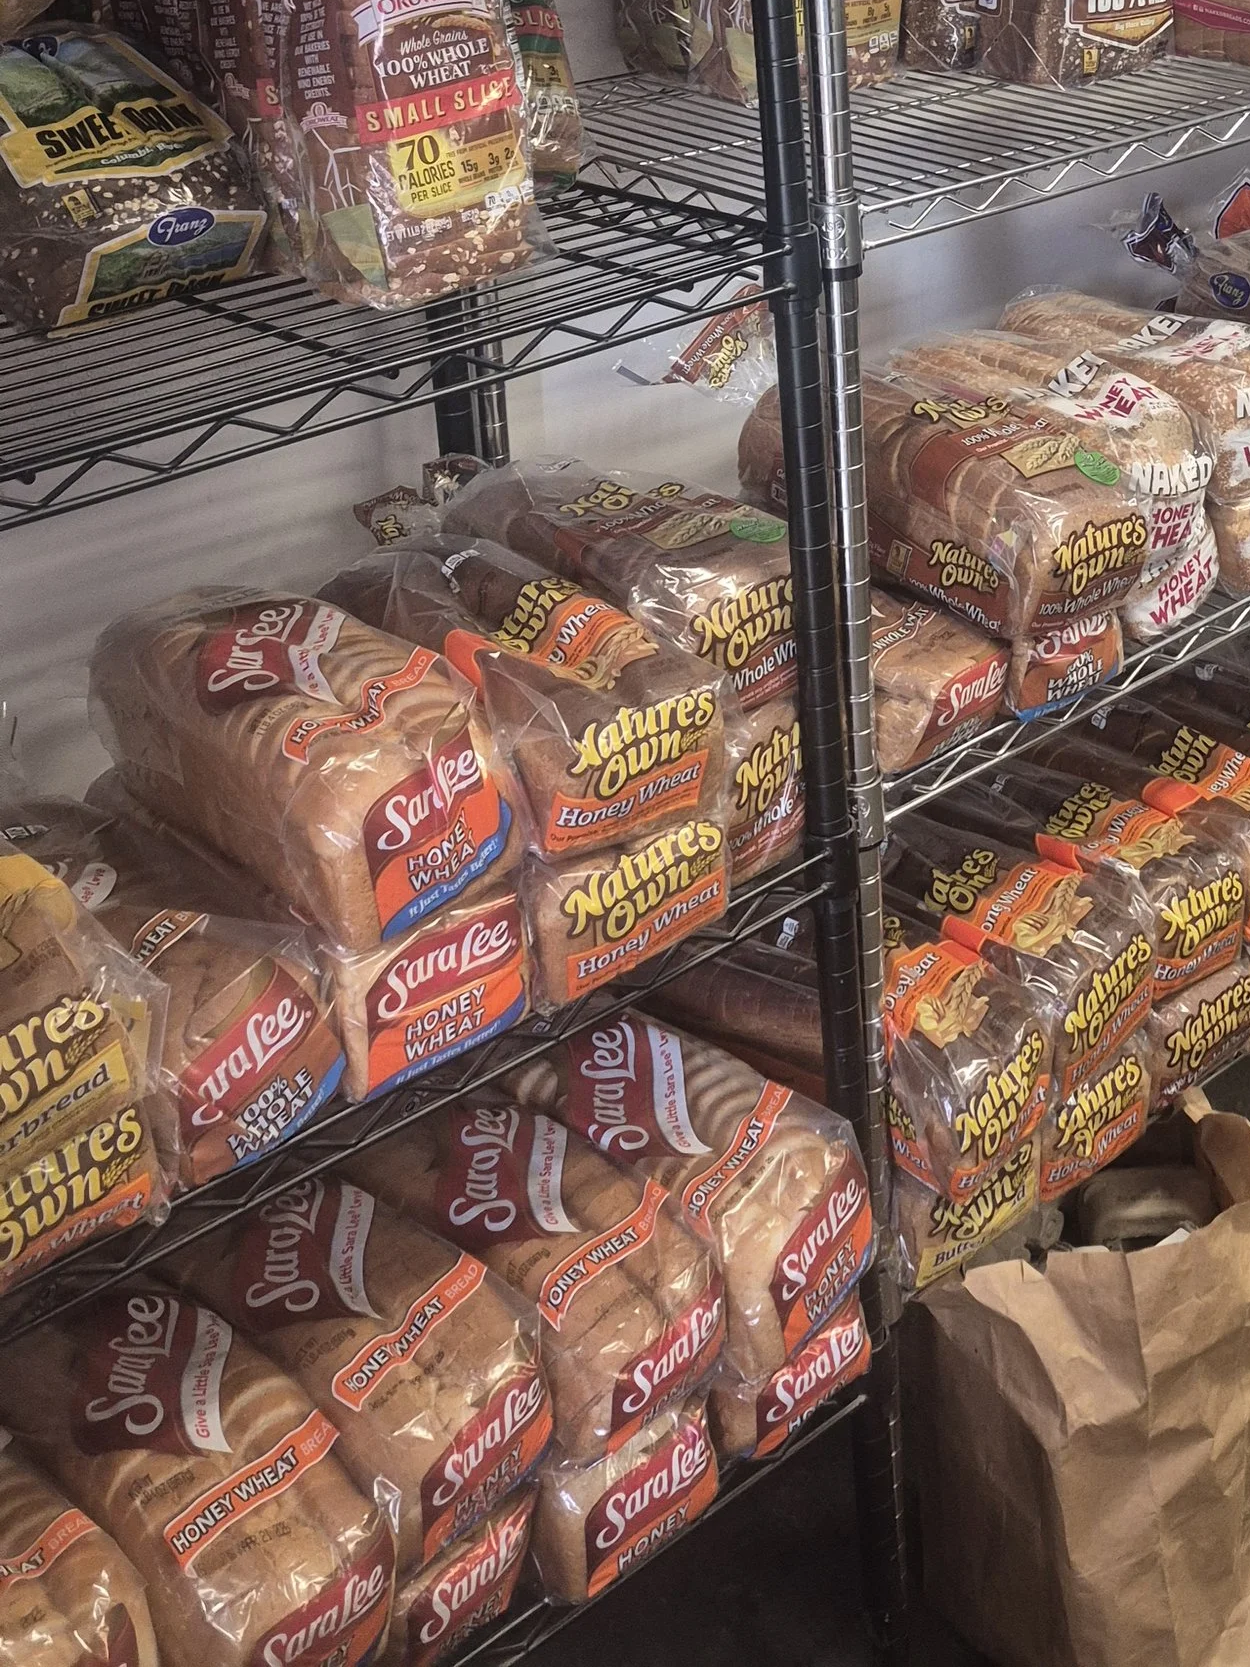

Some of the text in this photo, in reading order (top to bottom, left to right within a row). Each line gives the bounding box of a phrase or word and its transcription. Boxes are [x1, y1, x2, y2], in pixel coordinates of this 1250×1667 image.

[379, 38, 490, 78] 100% WHOLE
[400, 29, 469, 54] Whole Grains
[409, 60, 471, 89] WHEAT
[365, 96, 446, 132] SMALL
[396, 134, 440, 171] 70
[398, 159, 455, 191] CALORIES
[411, 184, 453, 204] PER SLICE
[157, 216, 208, 242] Franz
[1128, 455, 1213, 496] NAKED
[931, 540, 1001, 584] Nature's
[1054, 514, 1147, 574] Nature's
[1072, 547, 1126, 595] Own
[929, 583, 965, 613] Whole
[941, 562, 985, 588] Own
[1039, 573, 1137, 616] 100% Whole Wheat
[1150, 555, 1213, 626] WHEAT
[1158, 550, 1201, 601] HONEY
[726, 606, 793, 668] Own
[731, 656, 774, 691] Whole
[572, 688, 716, 775] Nature's
[599, 730, 683, 798] Own
[556, 762, 701, 828] Honey Wheat
[407, 808, 468, 872] HONEY
[409, 829, 477, 892] WHEAT
[418, 886, 440, 911] Just
[565, 820, 723, 936] Nature's
[606, 861, 692, 940] Own
[1165, 871, 1243, 942] Nature's
[577, 881, 721, 979] Honey Wheat
[1155, 932, 1238, 981] Honey Wheat
[1184, 906, 1229, 958] Own
[406, 984, 487, 1040] HONEY
[1066, 932, 1151, 1052] Nature's
[1089, 974, 1134, 1046] Own
[1110, 986, 1150, 1035] Wheat
[405, 1008, 486, 1063] WHEAT
[406, 1045, 462, 1080] Just Tastes
[1189, 1012, 1240, 1070] Own
[228, 1069, 313, 1150] WHOLE
[240, 1076, 288, 1128] 100%
[666, 1070, 676, 1094] Sara
[957, 1030, 1043, 1154] Nature's
[234, 1083, 314, 1159] WHEAT
[1047, 1110, 1139, 1183] Honey Wheat
[687, 1168, 723, 1218] HONEY
[722, 1116, 764, 1175] WHEAT
[585, 1186, 662, 1268] WHEAT BREAD
[804, 1234, 854, 1303] HONEY
[808, 1254, 857, 1322] WHEAT
[345, 1263, 479, 1394] HONEY WHEAT BREAD
[191, 1408, 210, 1439] Give
[172, 1446, 299, 1554] HONEY WHEAT
[617, 1501, 692, 1571] HONEY
